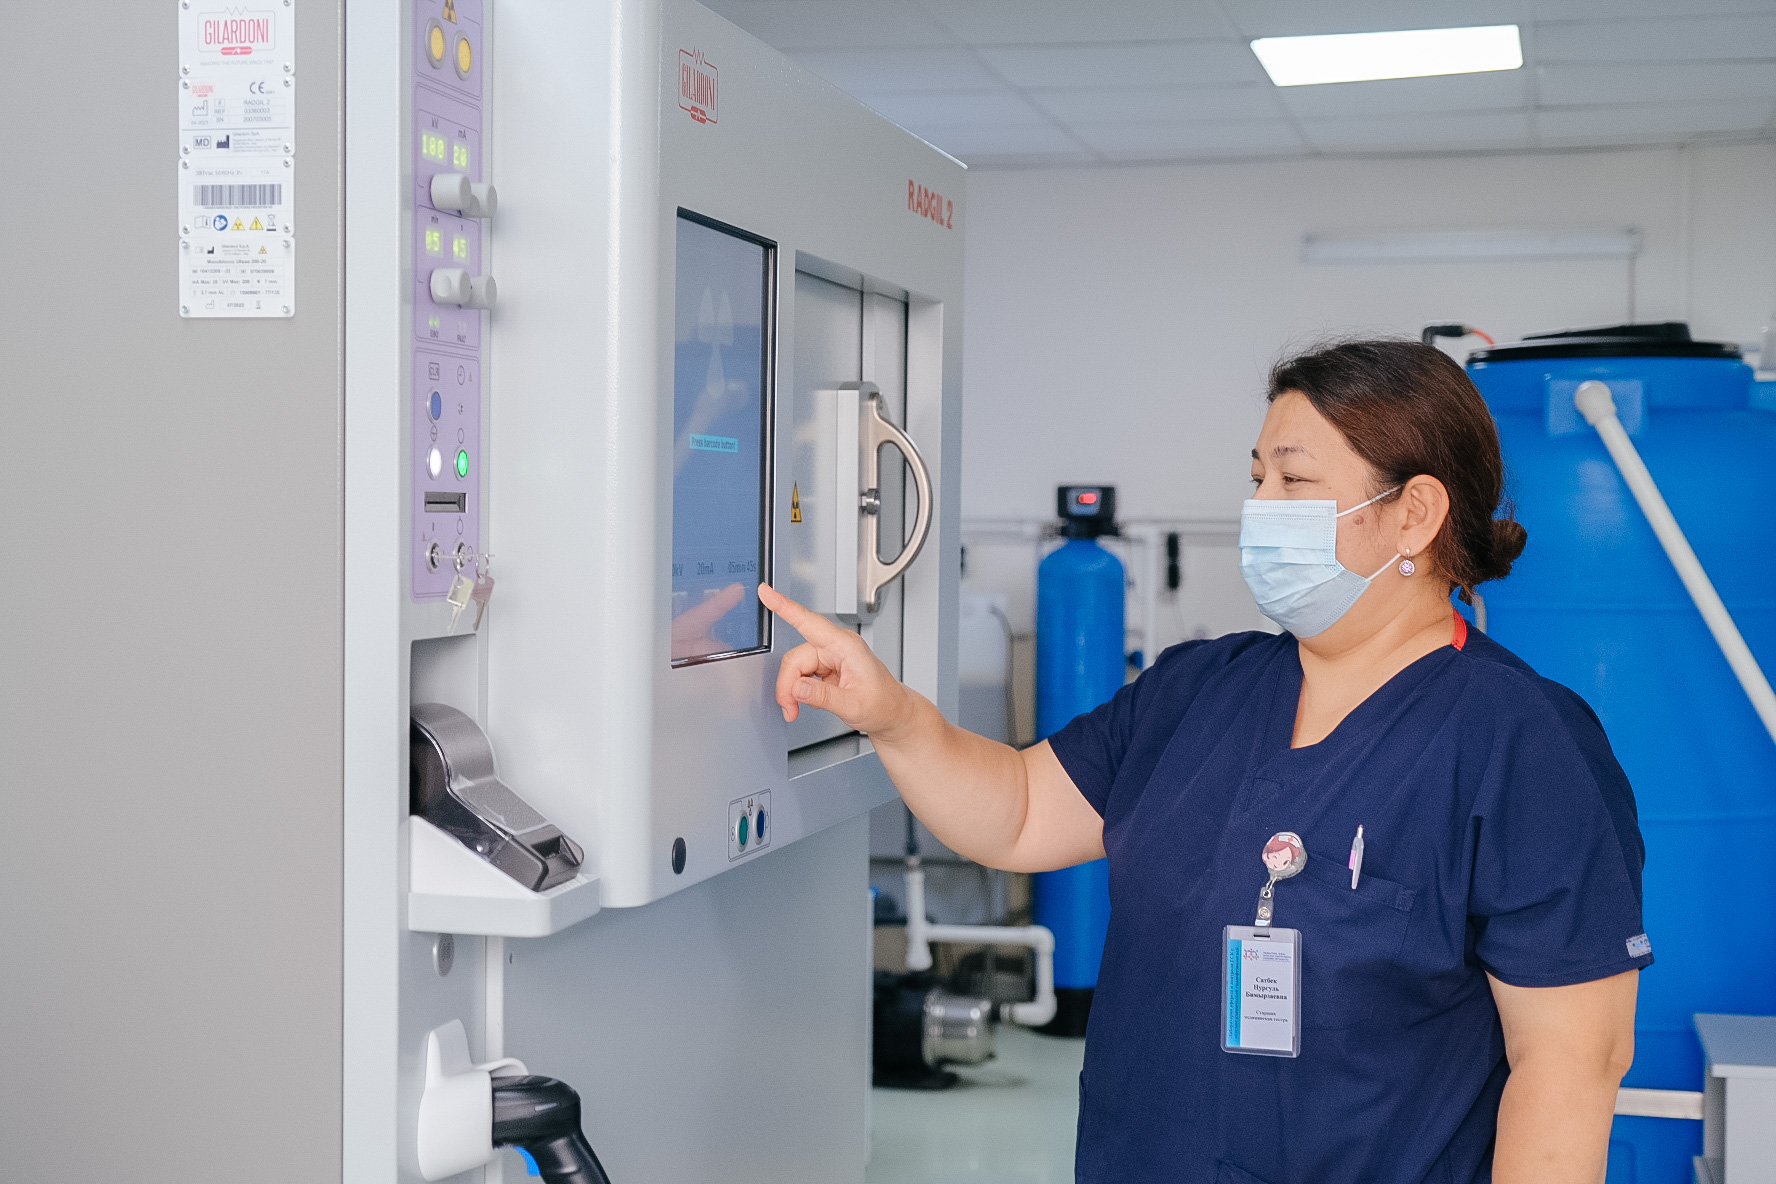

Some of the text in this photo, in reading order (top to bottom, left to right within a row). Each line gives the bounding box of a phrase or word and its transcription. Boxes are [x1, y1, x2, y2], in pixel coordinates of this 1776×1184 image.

[204, 18, 268, 44] GILARDONI
[682, 62, 714, 110] GILARDONI
[195, 138, 209, 146] MD
[422, 134, 445, 159] 180
[908, 179, 953, 230] RADGIL 2
[692, 436, 703, 447] Press
[704, 438, 720, 448] barcode
[697, 562, 714, 575] 20mA
[1253, 984, 1280, 992] Нургуль
